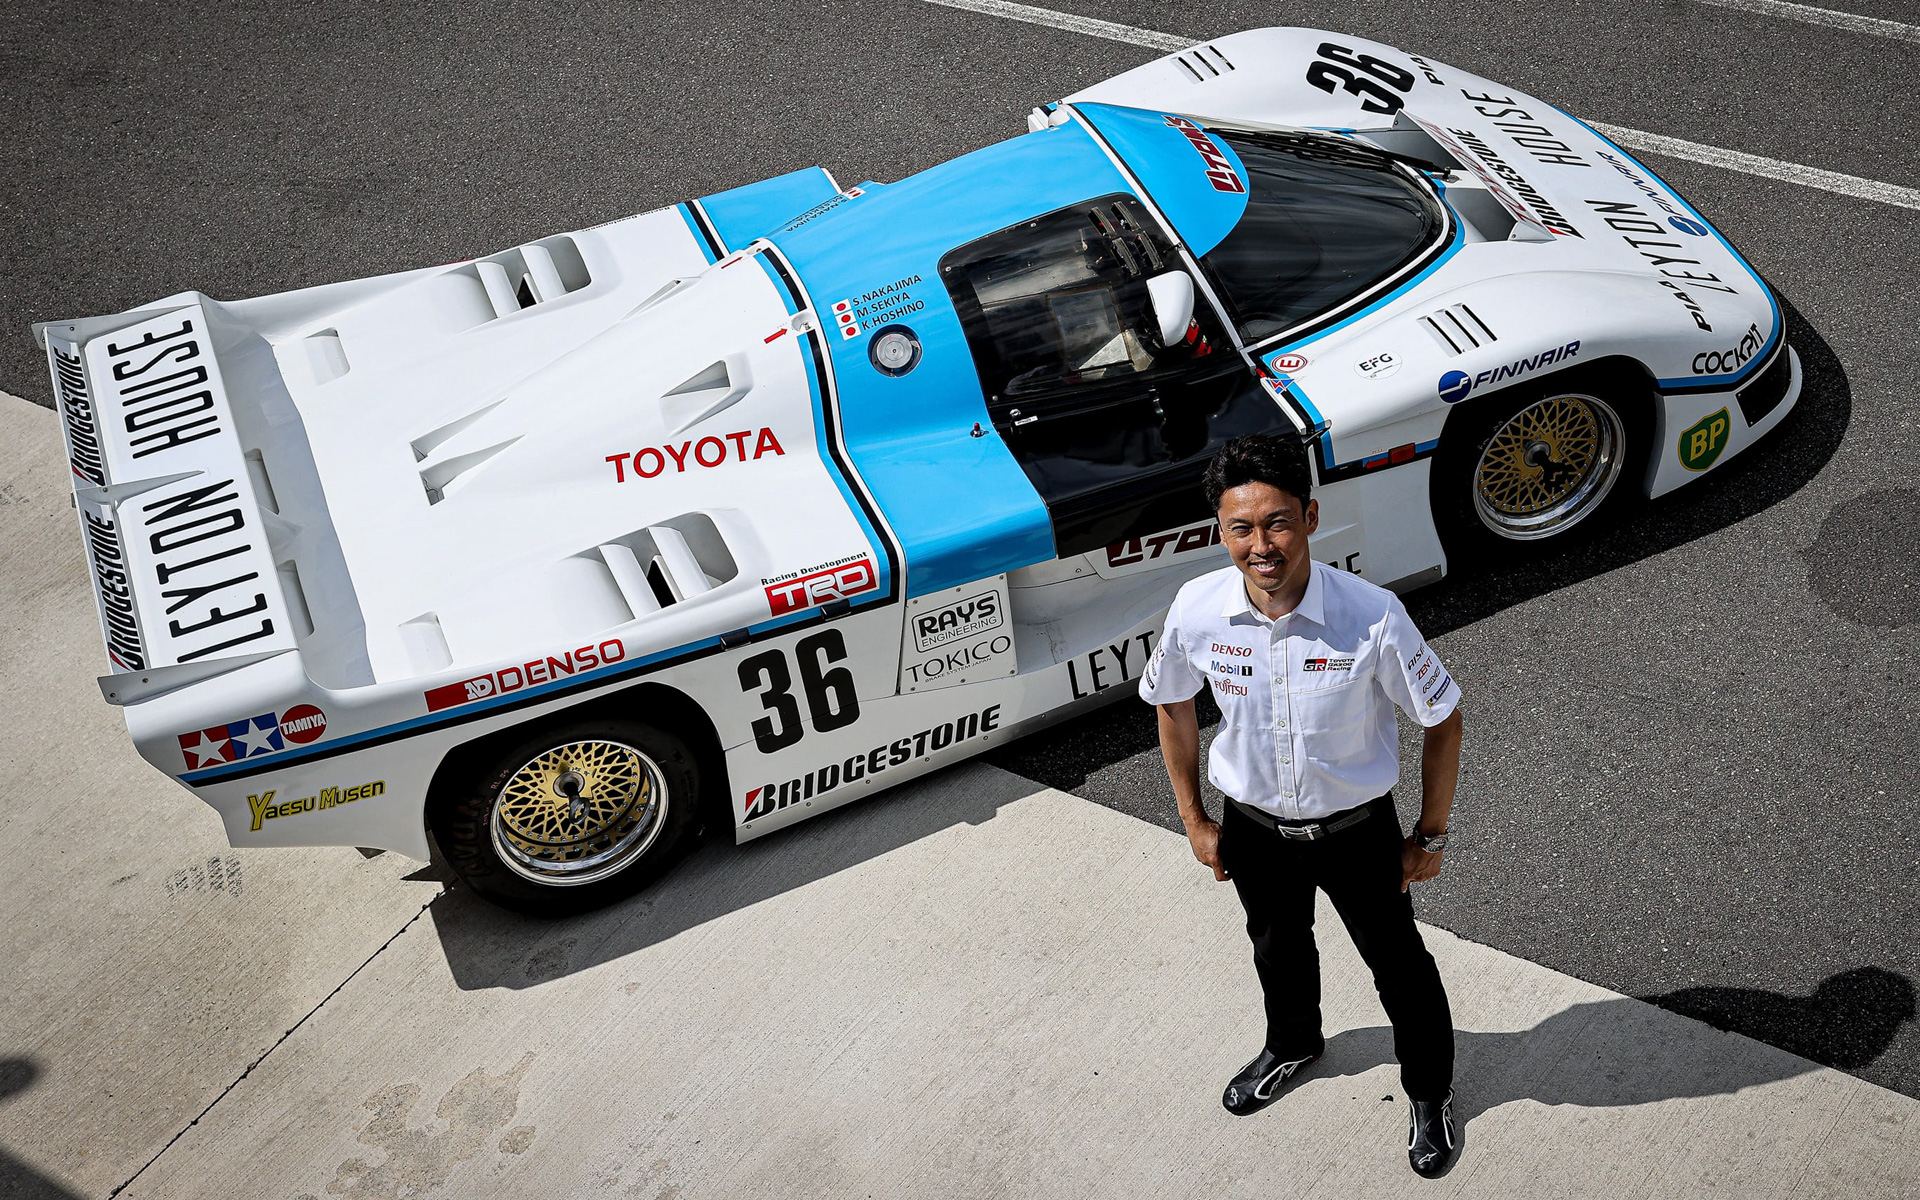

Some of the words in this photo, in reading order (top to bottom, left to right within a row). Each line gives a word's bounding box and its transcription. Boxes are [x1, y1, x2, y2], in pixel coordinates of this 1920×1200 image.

[1306, 43, 1415, 115] 36
[1408, 52, 1445, 85] PIA
[1460, 88, 1592, 167] HOUSE
[1446, 127, 1586, 240] BRIDGESTONE
[1595, 150, 1683, 216] FINNAIR
[1584, 199, 1739, 295] LEYTON
[852, 274, 922, 306] S.NAKAJIMA
[856, 291, 911, 318] M.SEKIYA
[1658, 280, 1712, 333] PIAA
[861, 300, 925, 331] K.HOSHINO
[1358, 353, 1393, 372] EFG
[1473, 340, 1581, 389] FINNAIR
[1691, 322, 1764, 375] COCKPIT
[107, 319, 222, 460] HOUSE
[53, 345, 106, 487] BRIDGESTONE
[1690, 417, 1726, 462] BP
[605, 427, 785, 483] TOYOTA
[84, 509, 147, 672] BRIDGESTONE
[142, 478, 275, 663] LEYTON
[760, 571, 798, 586] Racing
[800, 551, 868, 575] Development
[771, 565, 870, 607] TRD
[918, 596, 996, 638] RAYS
[921, 616, 997, 648] ENGINEERING
[497, 639, 626, 693] DENSO
[905, 635, 1011, 683] TOKICO
[1067, 630, 1155, 701] LEYT
[1210, 660, 1240, 676] Mobil
[1211, 642, 1253, 657] DENSO
[1303, 661, 1327, 671] GR
[1415, 655, 1433, 681] ZENT
[737, 628, 861, 755] 36
[1214, 678, 1248, 697] FUJITSU
[280, 713, 327, 736] TAMIYA
[741, 703, 1001, 825] BRIDGESTONE
